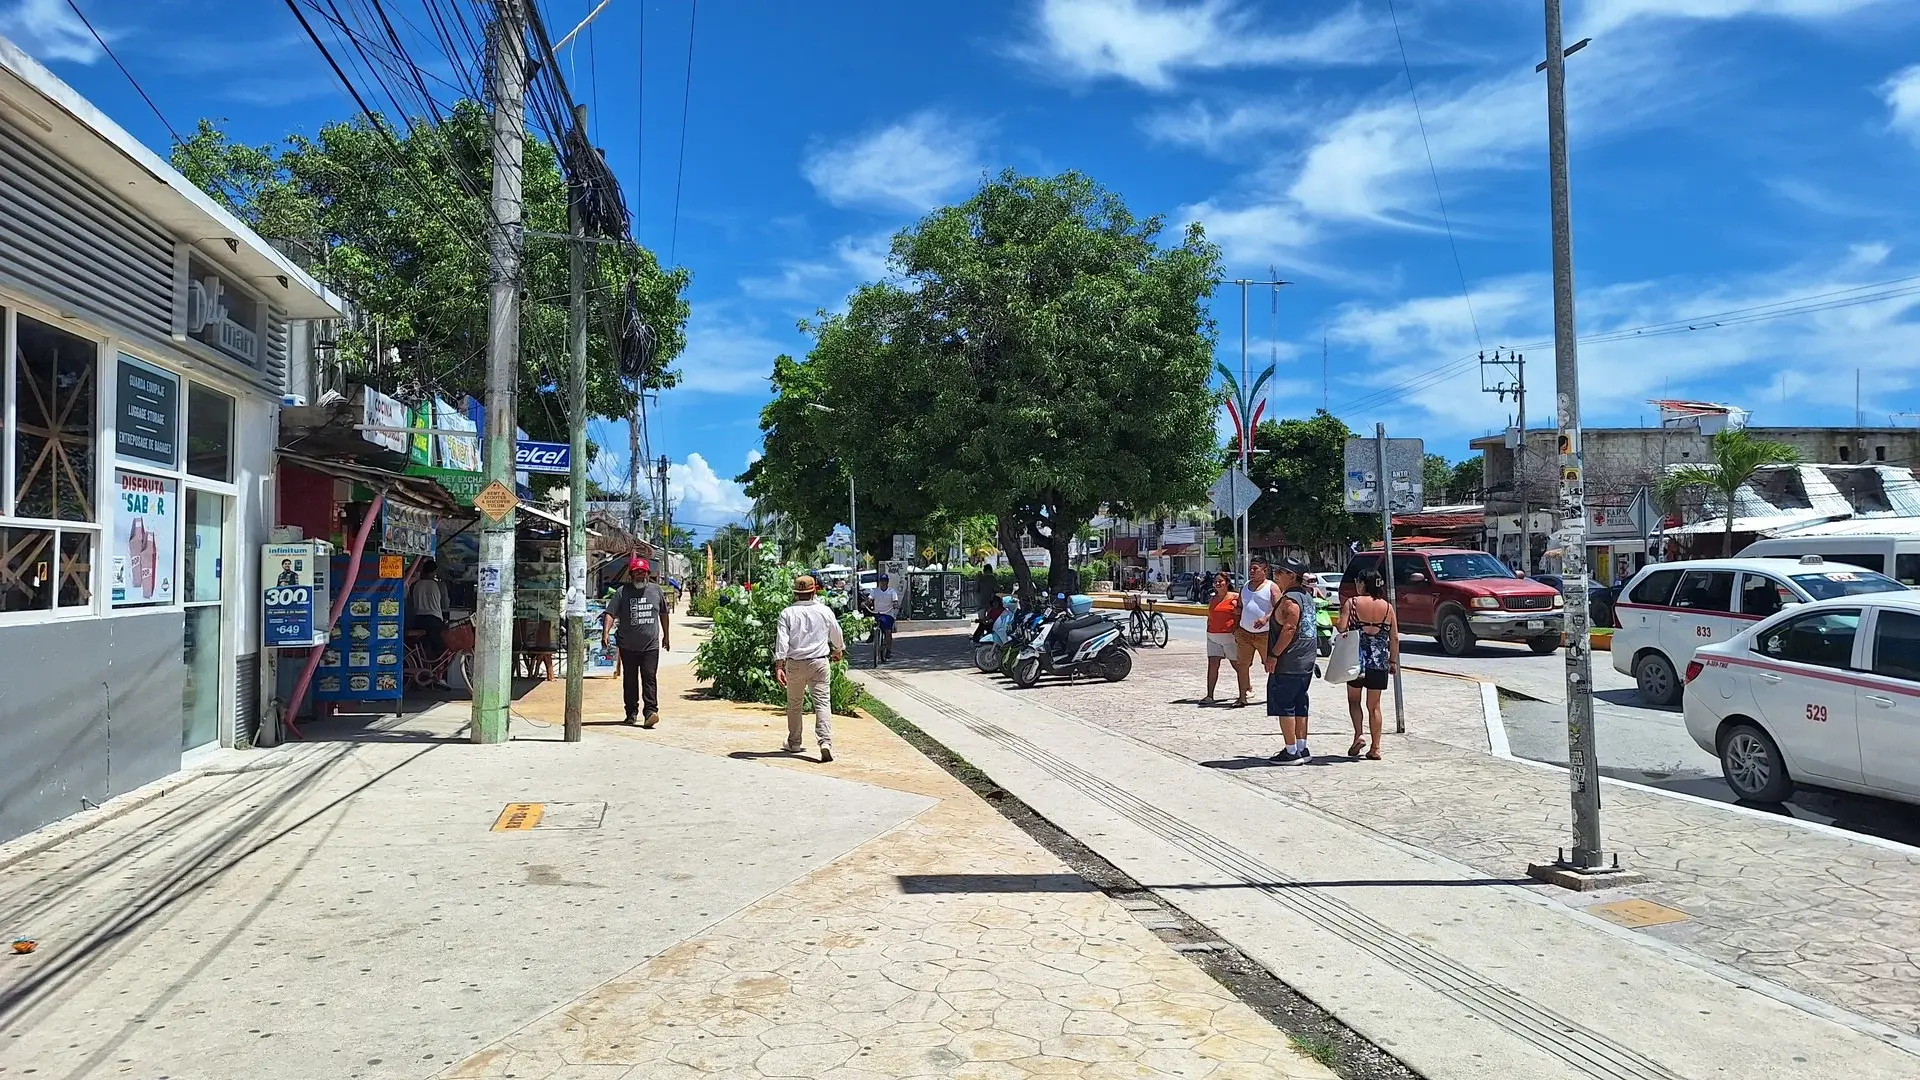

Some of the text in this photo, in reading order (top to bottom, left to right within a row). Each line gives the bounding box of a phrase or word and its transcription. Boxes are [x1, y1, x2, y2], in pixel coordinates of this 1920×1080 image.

[222, 323, 255, 358] mart
[129, 374, 166, 397] GUARDA EQUIPAJE
[128, 403, 165, 426] LUGGAGE STORAGE
[118, 431, 173, 455] ENTREPOSAGE DE BAGAGES
[516, 446, 567, 465] elcel
[122, 475, 165, 495] DISFRUTA
[443, 482, 482, 494] CAPIT
[459, 475, 483, 484] EXCHA
[121, 493, 165, 516] EL SABR
[1607, 508, 1628, 518] FARM
[268, 547, 308, 555] infinitum
[265, 588, 308, 606] 300
[1696, 626, 1712, 638] 833
[1806, 703, 1827, 722] 529
